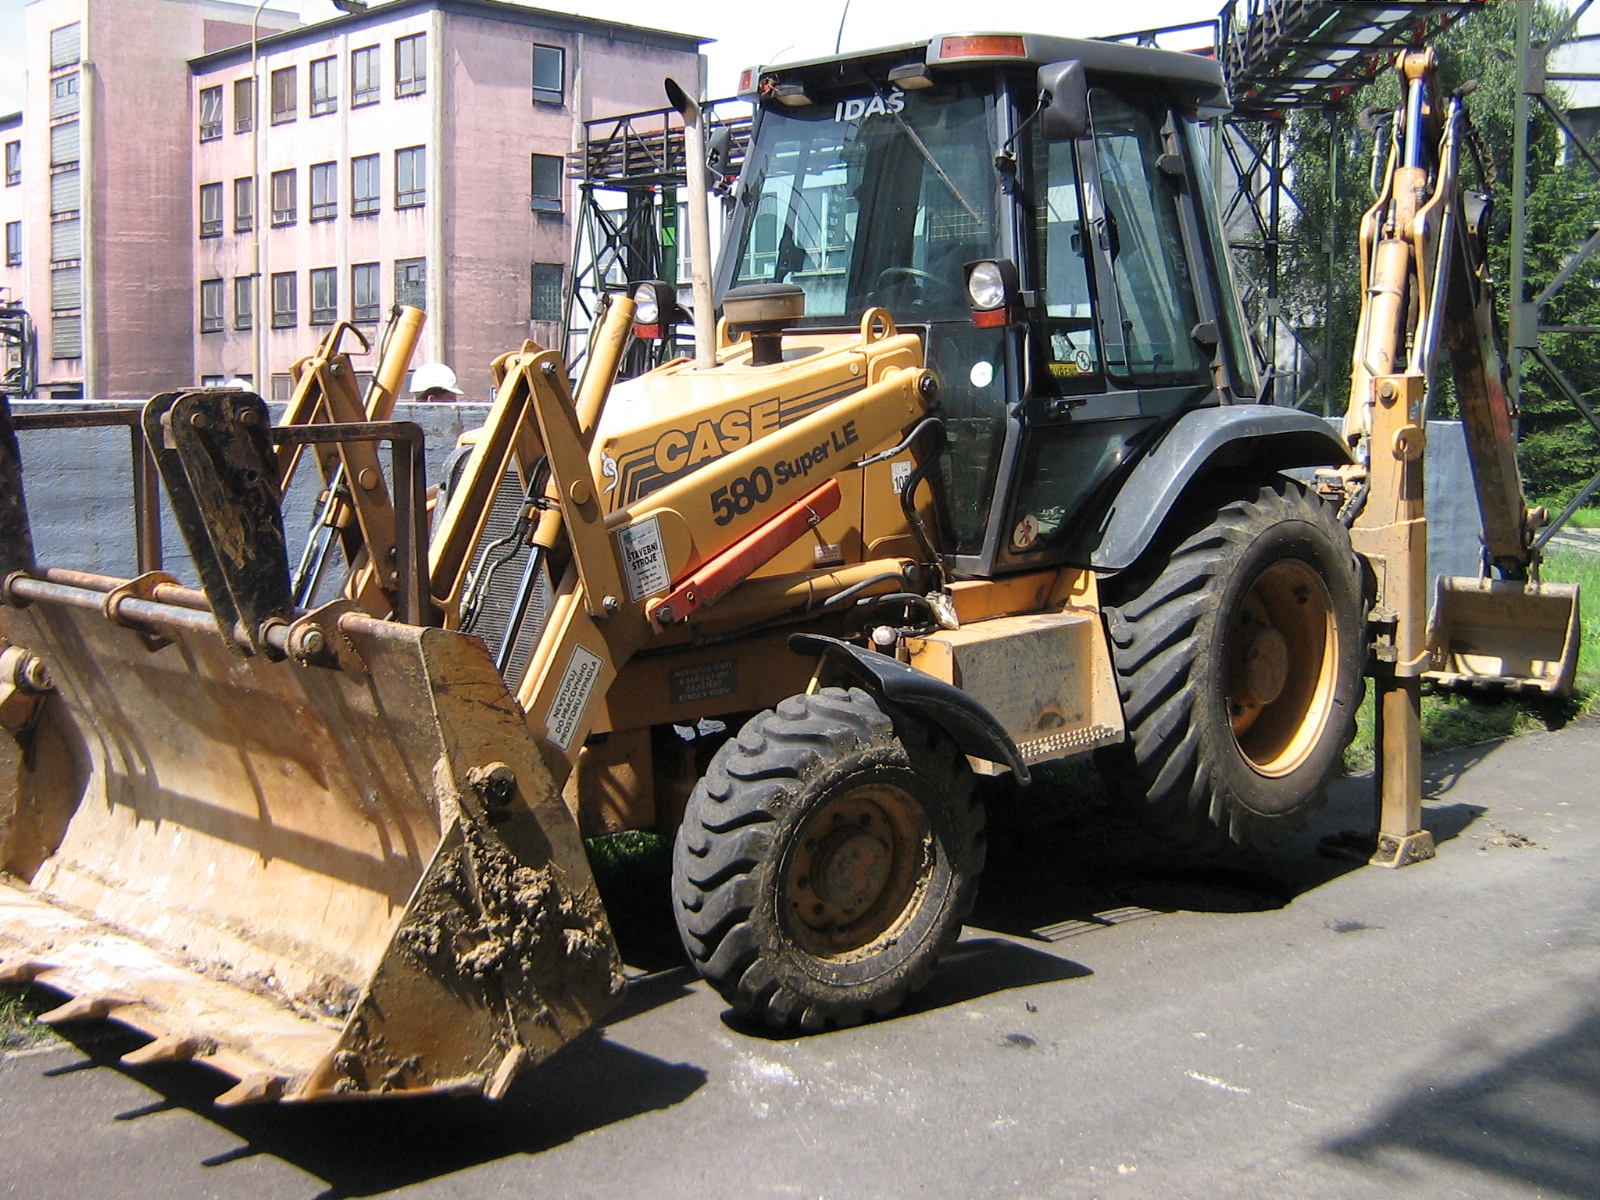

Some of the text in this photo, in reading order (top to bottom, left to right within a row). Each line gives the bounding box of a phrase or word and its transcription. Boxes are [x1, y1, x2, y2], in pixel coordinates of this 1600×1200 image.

[654, 397, 781, 474] CASE
[711, 420, 859, 526] 580 Super LE
[632, 553, 658, 571] STROJE
[553, 670, 577, 719] NEVSTUPUJ
[555, 662, 588, 734] DO PRACOVNÍHO
[560, 661, 598, 744] PROSTORU RYPADLA
